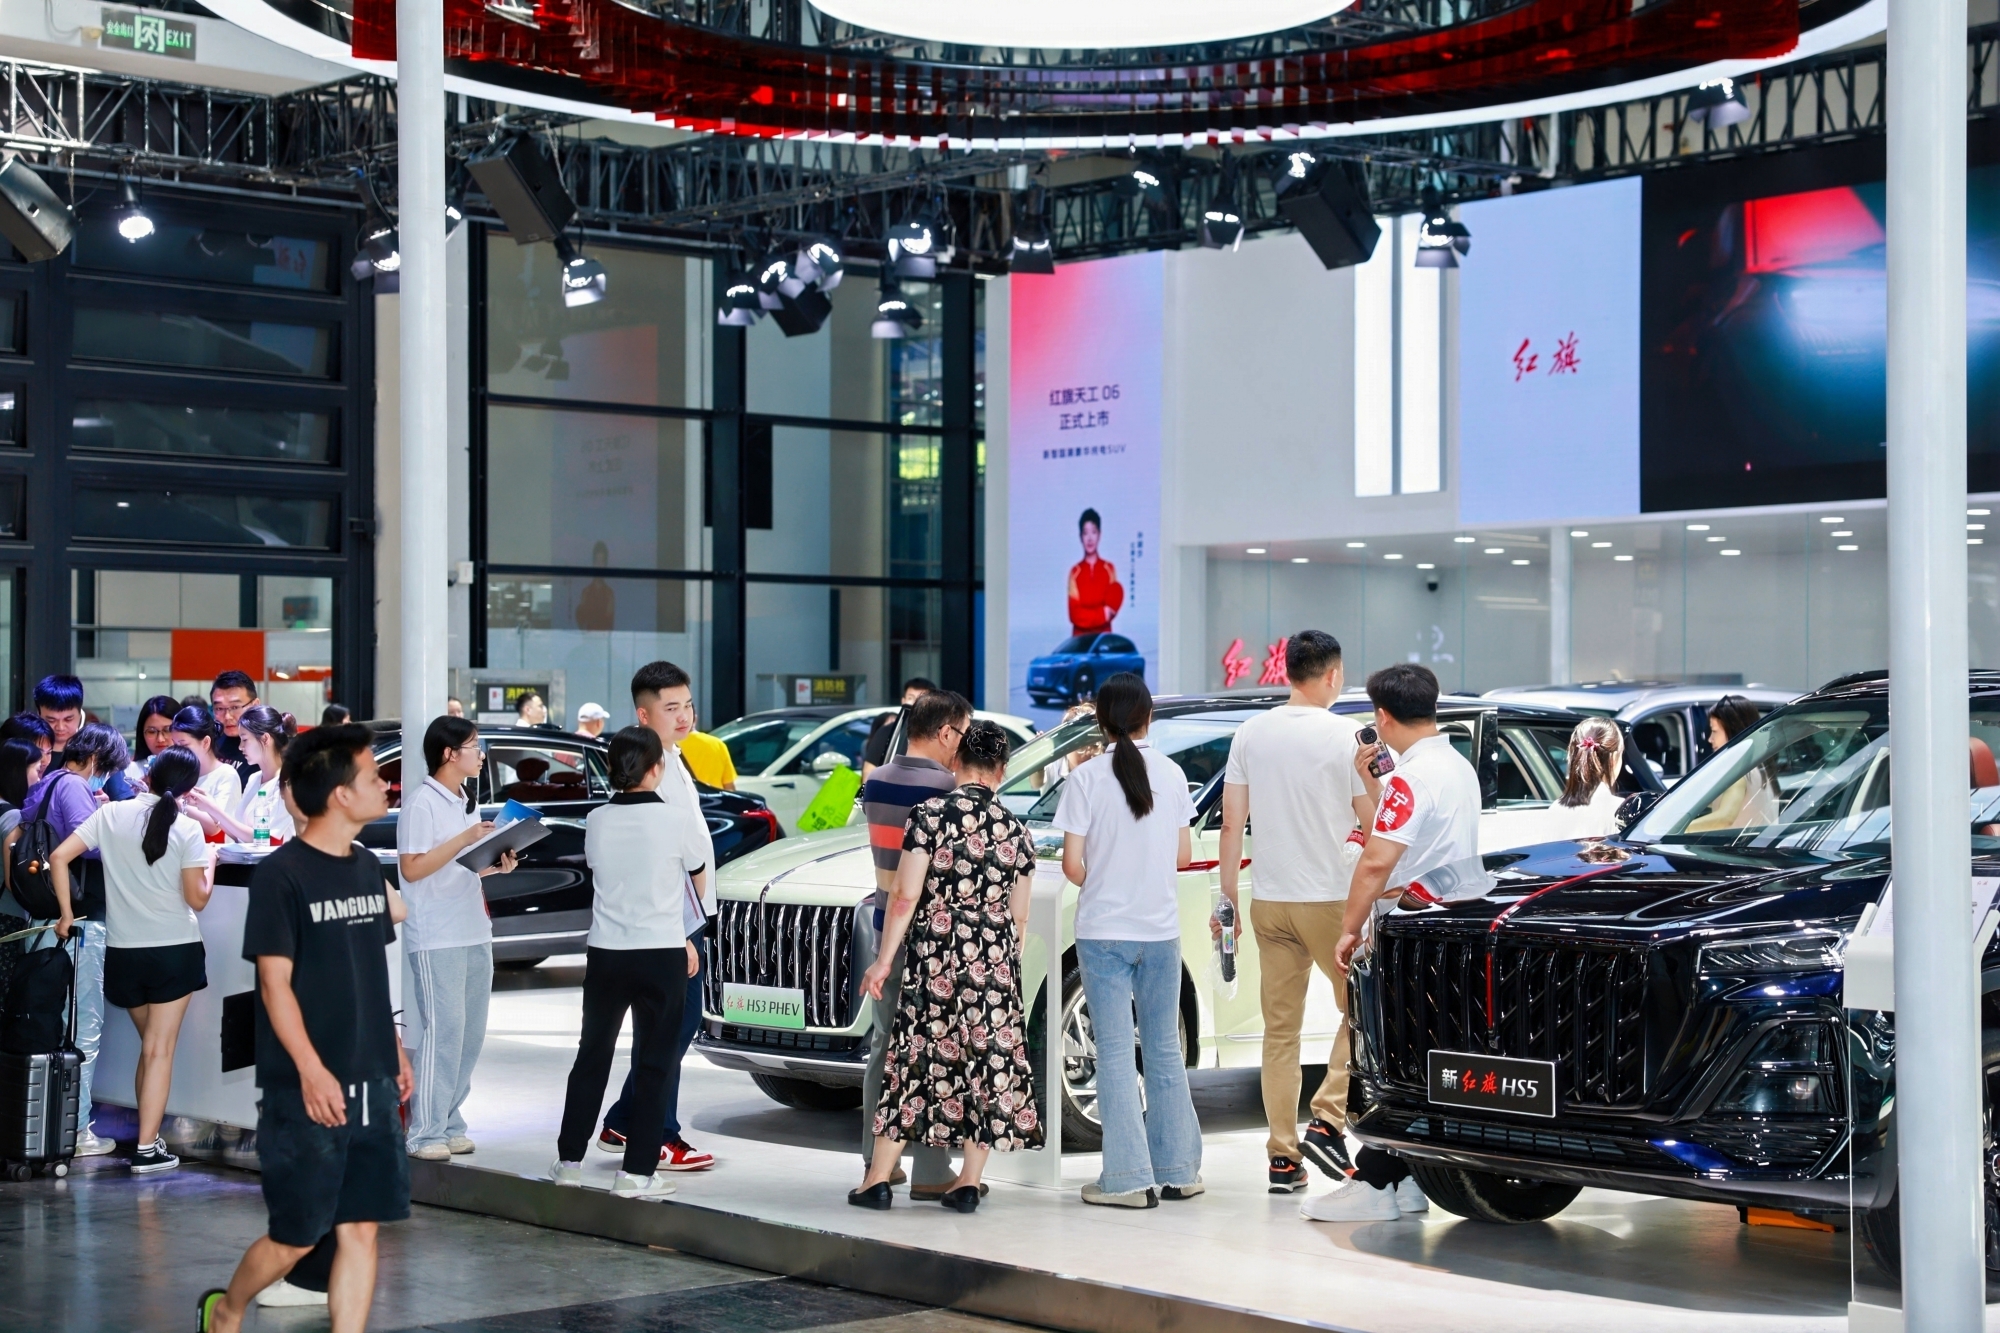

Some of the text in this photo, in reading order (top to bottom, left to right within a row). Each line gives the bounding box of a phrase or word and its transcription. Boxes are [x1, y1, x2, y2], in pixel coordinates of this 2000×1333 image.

[106, 20, 192, 49] 安全出口 EXIT
[1513, 331, 1581, 382] 红旗
[1049, 384, 1120, 406] 红旗天工 06
[1059, 410, 1109, 430] 正式上市
[506, 687, 537, 700] 消防
[747, 998, 767, 1013] HS3
[768, 1001, 800, 1016] PHEV
[1501, 1077, 1539, 1098] HS5
